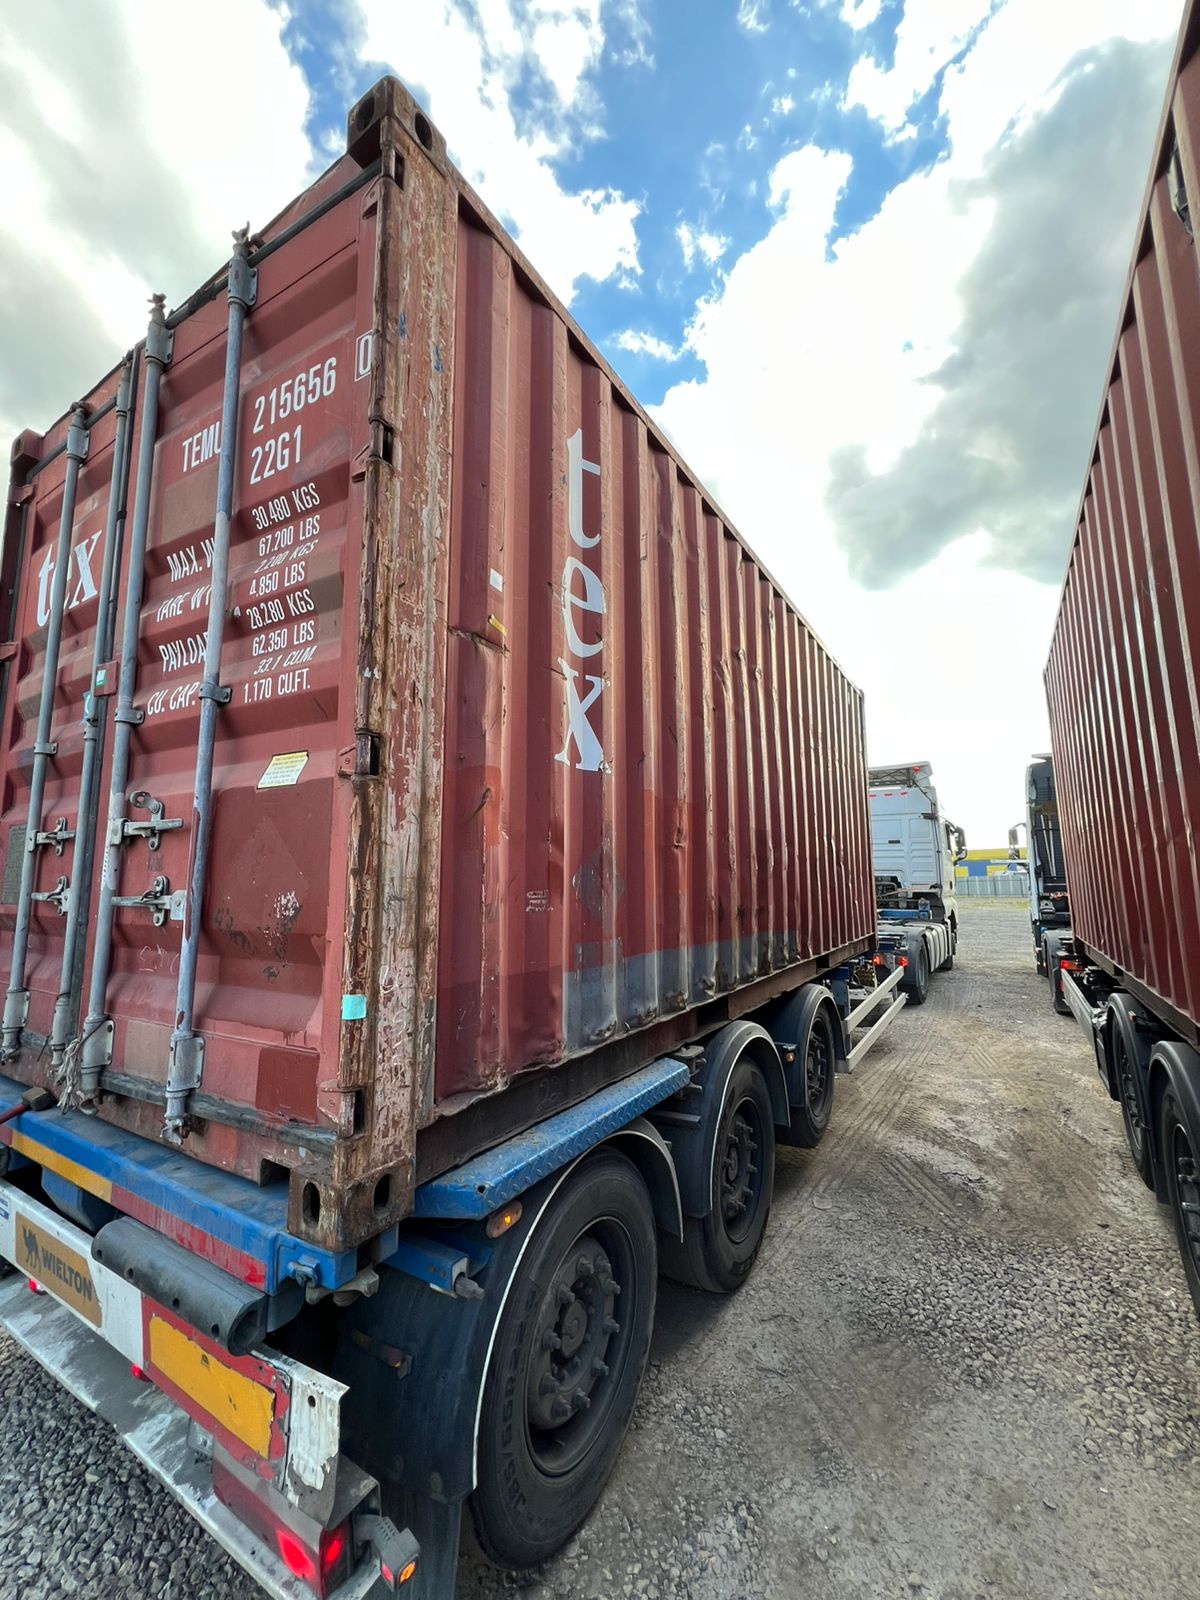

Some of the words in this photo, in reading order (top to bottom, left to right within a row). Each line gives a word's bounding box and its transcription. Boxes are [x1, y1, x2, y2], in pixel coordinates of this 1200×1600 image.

[182, 421, 222, 472] TEMU
[252, 357, 337, 434] 215656
[250, 425, 302, 485] 22G1
[167, 546, 203, 582] MAX.
[200, 537, 216, 568] W
[252, 495, 291, 530] 30.480
[292, 482, 321, 512] KGS
[259, 524, 294, 556] 67.200
[299, 514, 320, 541] LBS
[249, 571, 279, 597] 4.850
[284, 561, 306, 587] LBS
[554, 428, 607, 771] tex
[156, 591, 191, 623] TARE
[158, 631, 209, 673] PAYLOA
[246, 598, 285, 630] 28.280
[285, 588, 315, 617] KGS
[252, 628, 288, 657] 62.350
[293, 620, 315, 646] LBS
[253, 654, 283, 675] 33.1
[147, 690, 165, 716] CU.
[169, 681, 200, 708] CAP.
[244, 677, 273, 704] 1.170
[277, 667, 311, 696] CU.FT.
[41, 1248, 92, 1301] WIELTON
